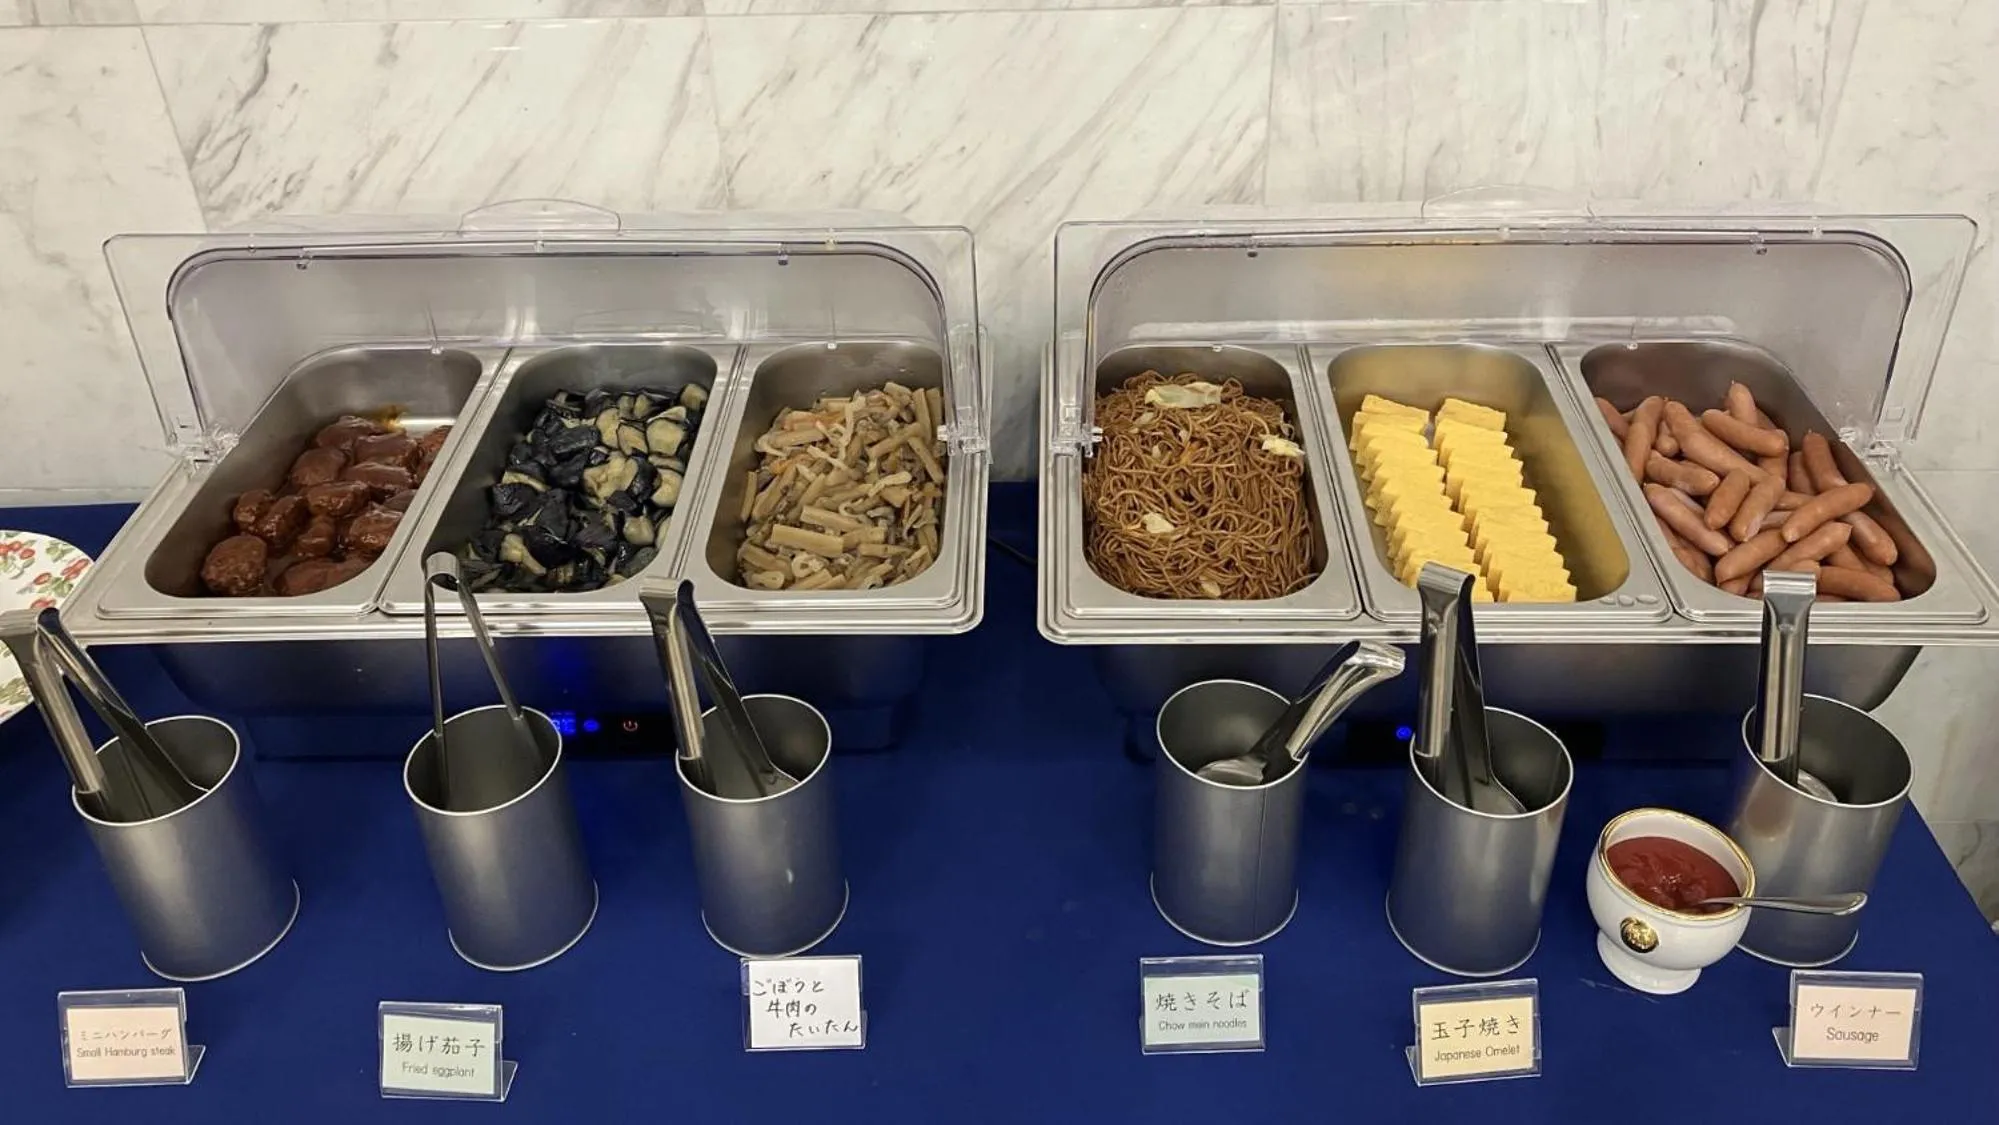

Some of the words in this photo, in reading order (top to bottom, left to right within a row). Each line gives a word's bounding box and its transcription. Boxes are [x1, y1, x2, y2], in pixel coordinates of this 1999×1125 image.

[752, 978, 824, 996] ごぼうと
[766, 998, 817, 1018] 牛肉の
[1156, 989, 1250, 1012] 焼きそば
[1810, 1003, 1901, 1019] ウインナー
[789, 1020, 858, 1038] たいたん
[1159, 1020, 1185, 1031] Chow
[1213, 1018, 1247, 1029] noodles
[1431, 1015, 1520, 1040] 玉子焼き
[80, 1027, 173, 1041] ミニハンバーグ
[1826, 1027, 1880, 1044] Sausage
[76, 1047, 102, 1058] Small
[105, 1046, 147, 1058] Hamburg
[151, 1045, 176, 1056] steak
[392, 1032, 485, 1057] 揚げ茄子
[1435, 1049, 1481, 1063] Japanese
[1485, 1044, 1520, 1057] Omelet
[402, 1061, 429, 1075] Fried
[432, 1064, 475, 1078] eggplant
